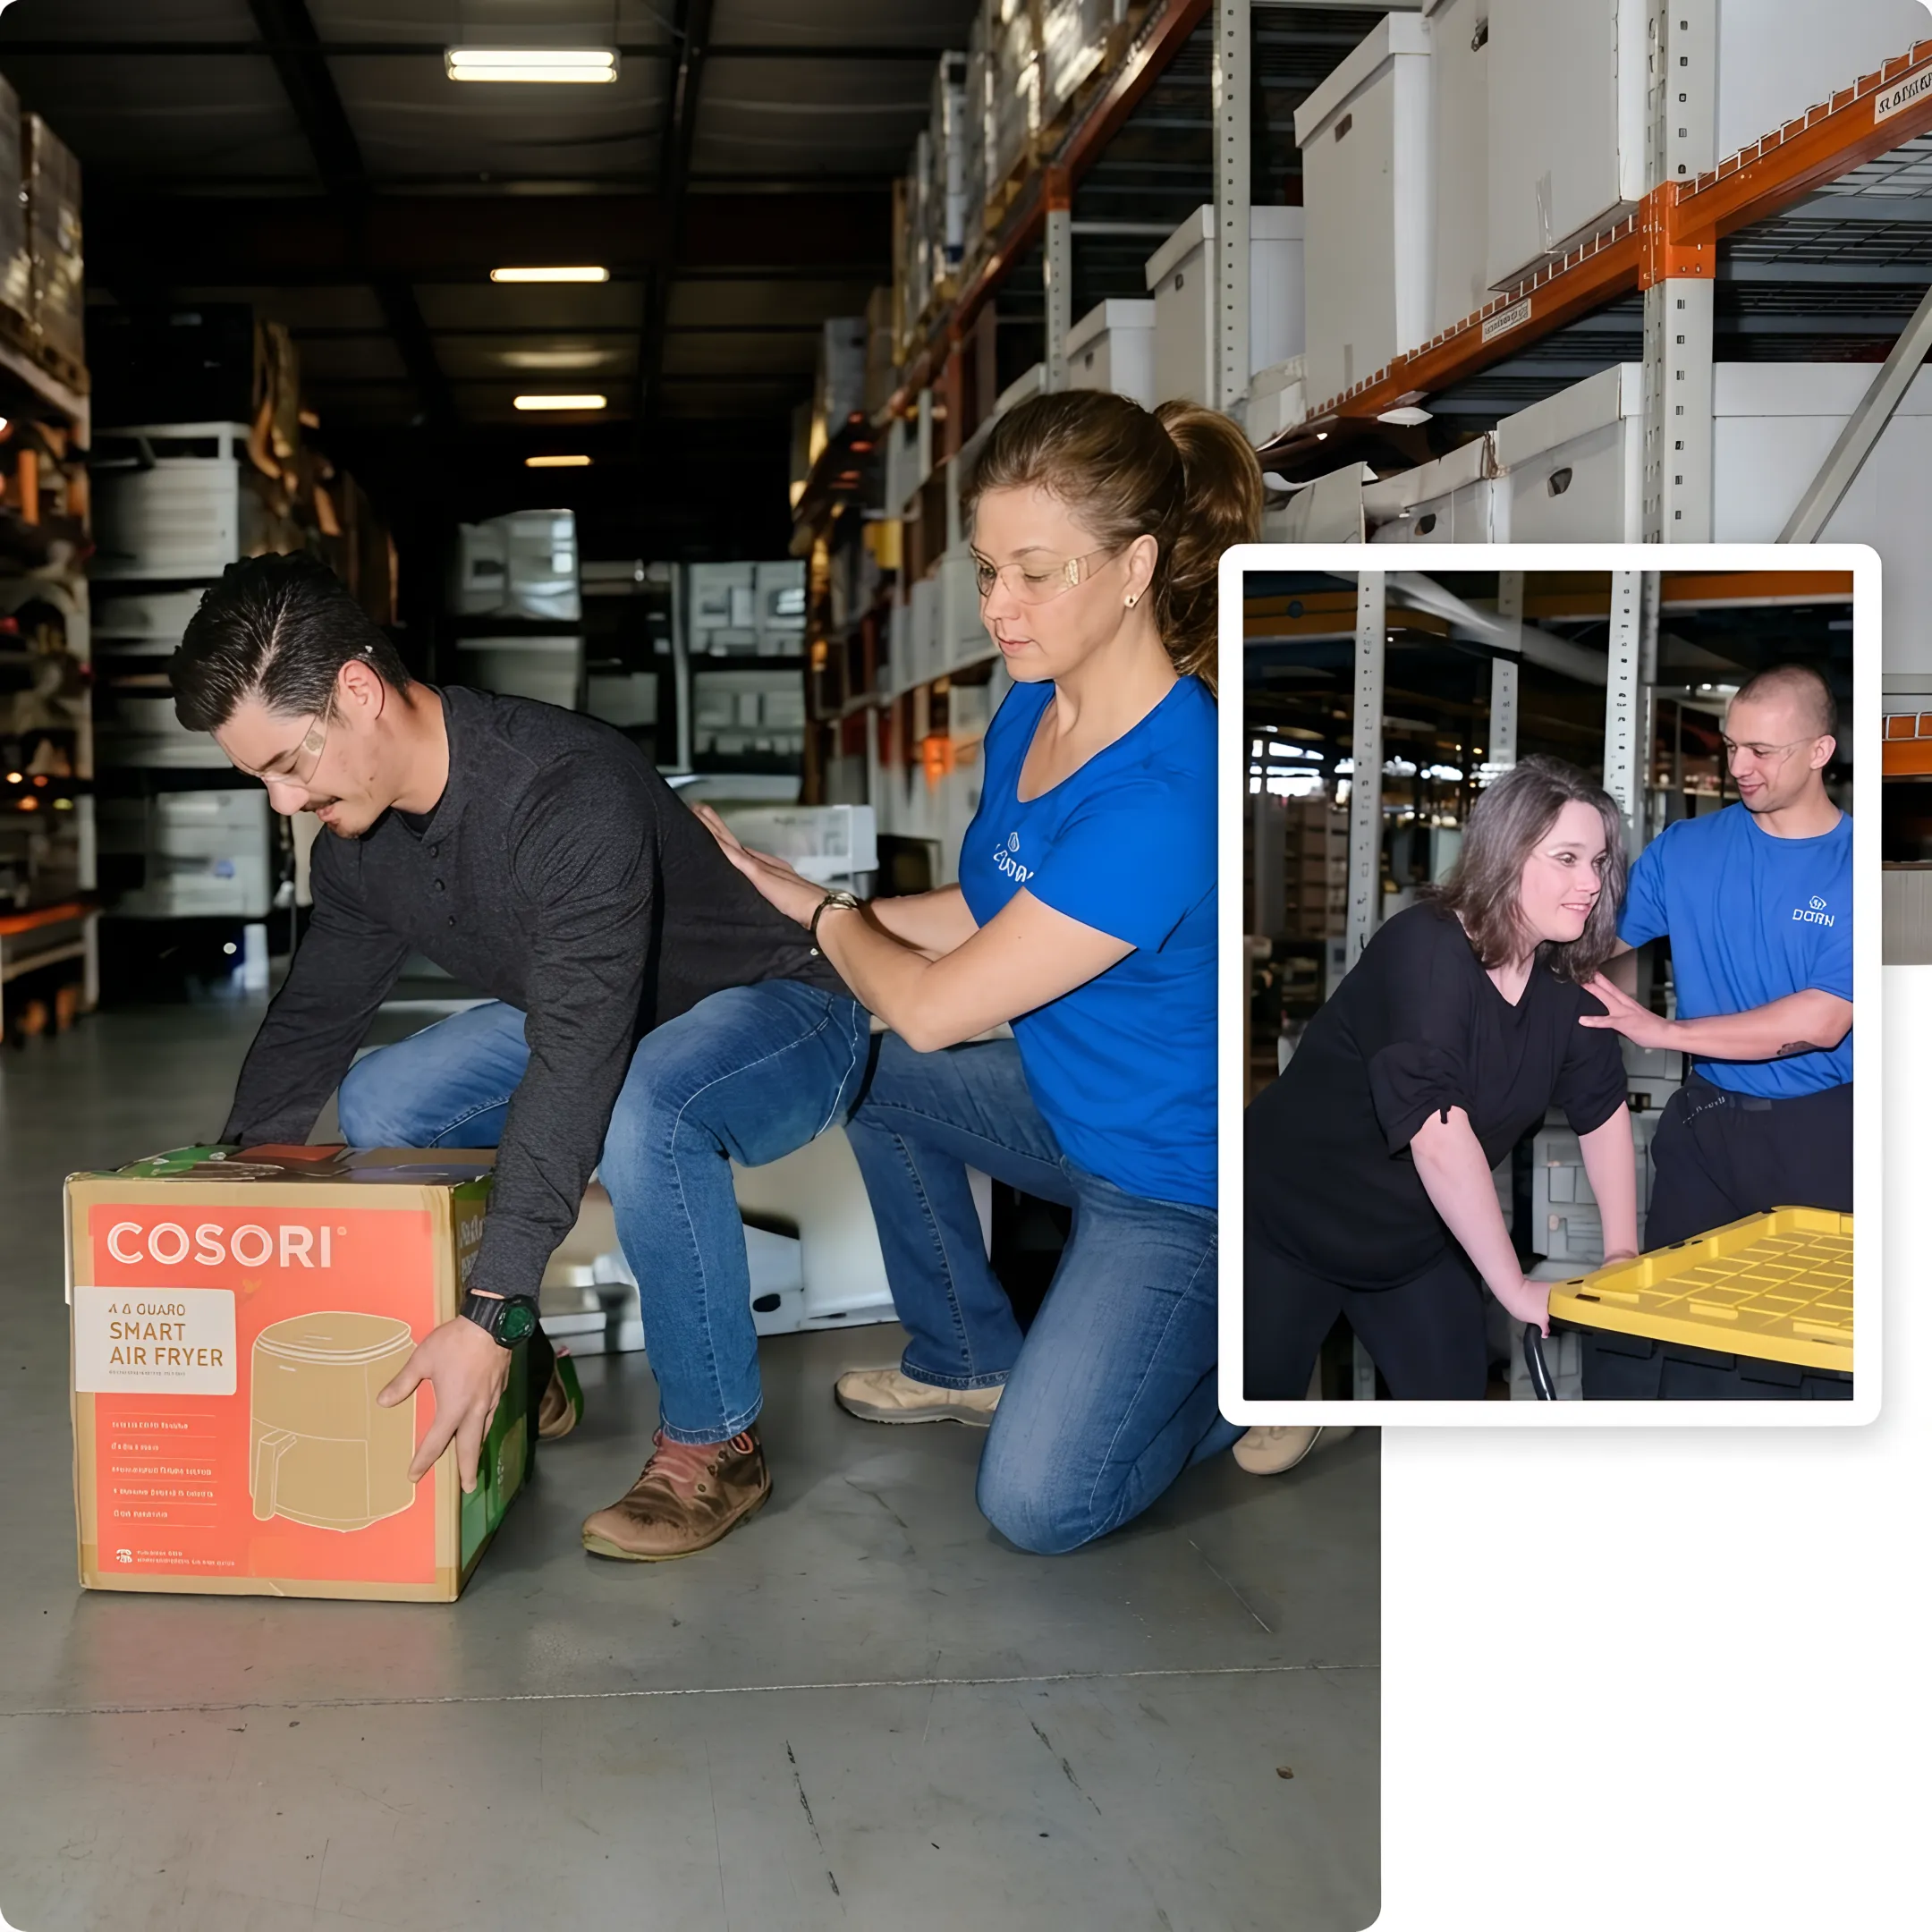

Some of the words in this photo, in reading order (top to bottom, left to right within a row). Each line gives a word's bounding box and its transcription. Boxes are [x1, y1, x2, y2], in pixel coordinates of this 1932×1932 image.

[106, 1221, 331, 1267] COSORI
[109, 1321, 186, 1342] SMART
[109, 1346, 147, 1366] AIR
[155, 1347, 224, 1367] FRYER
